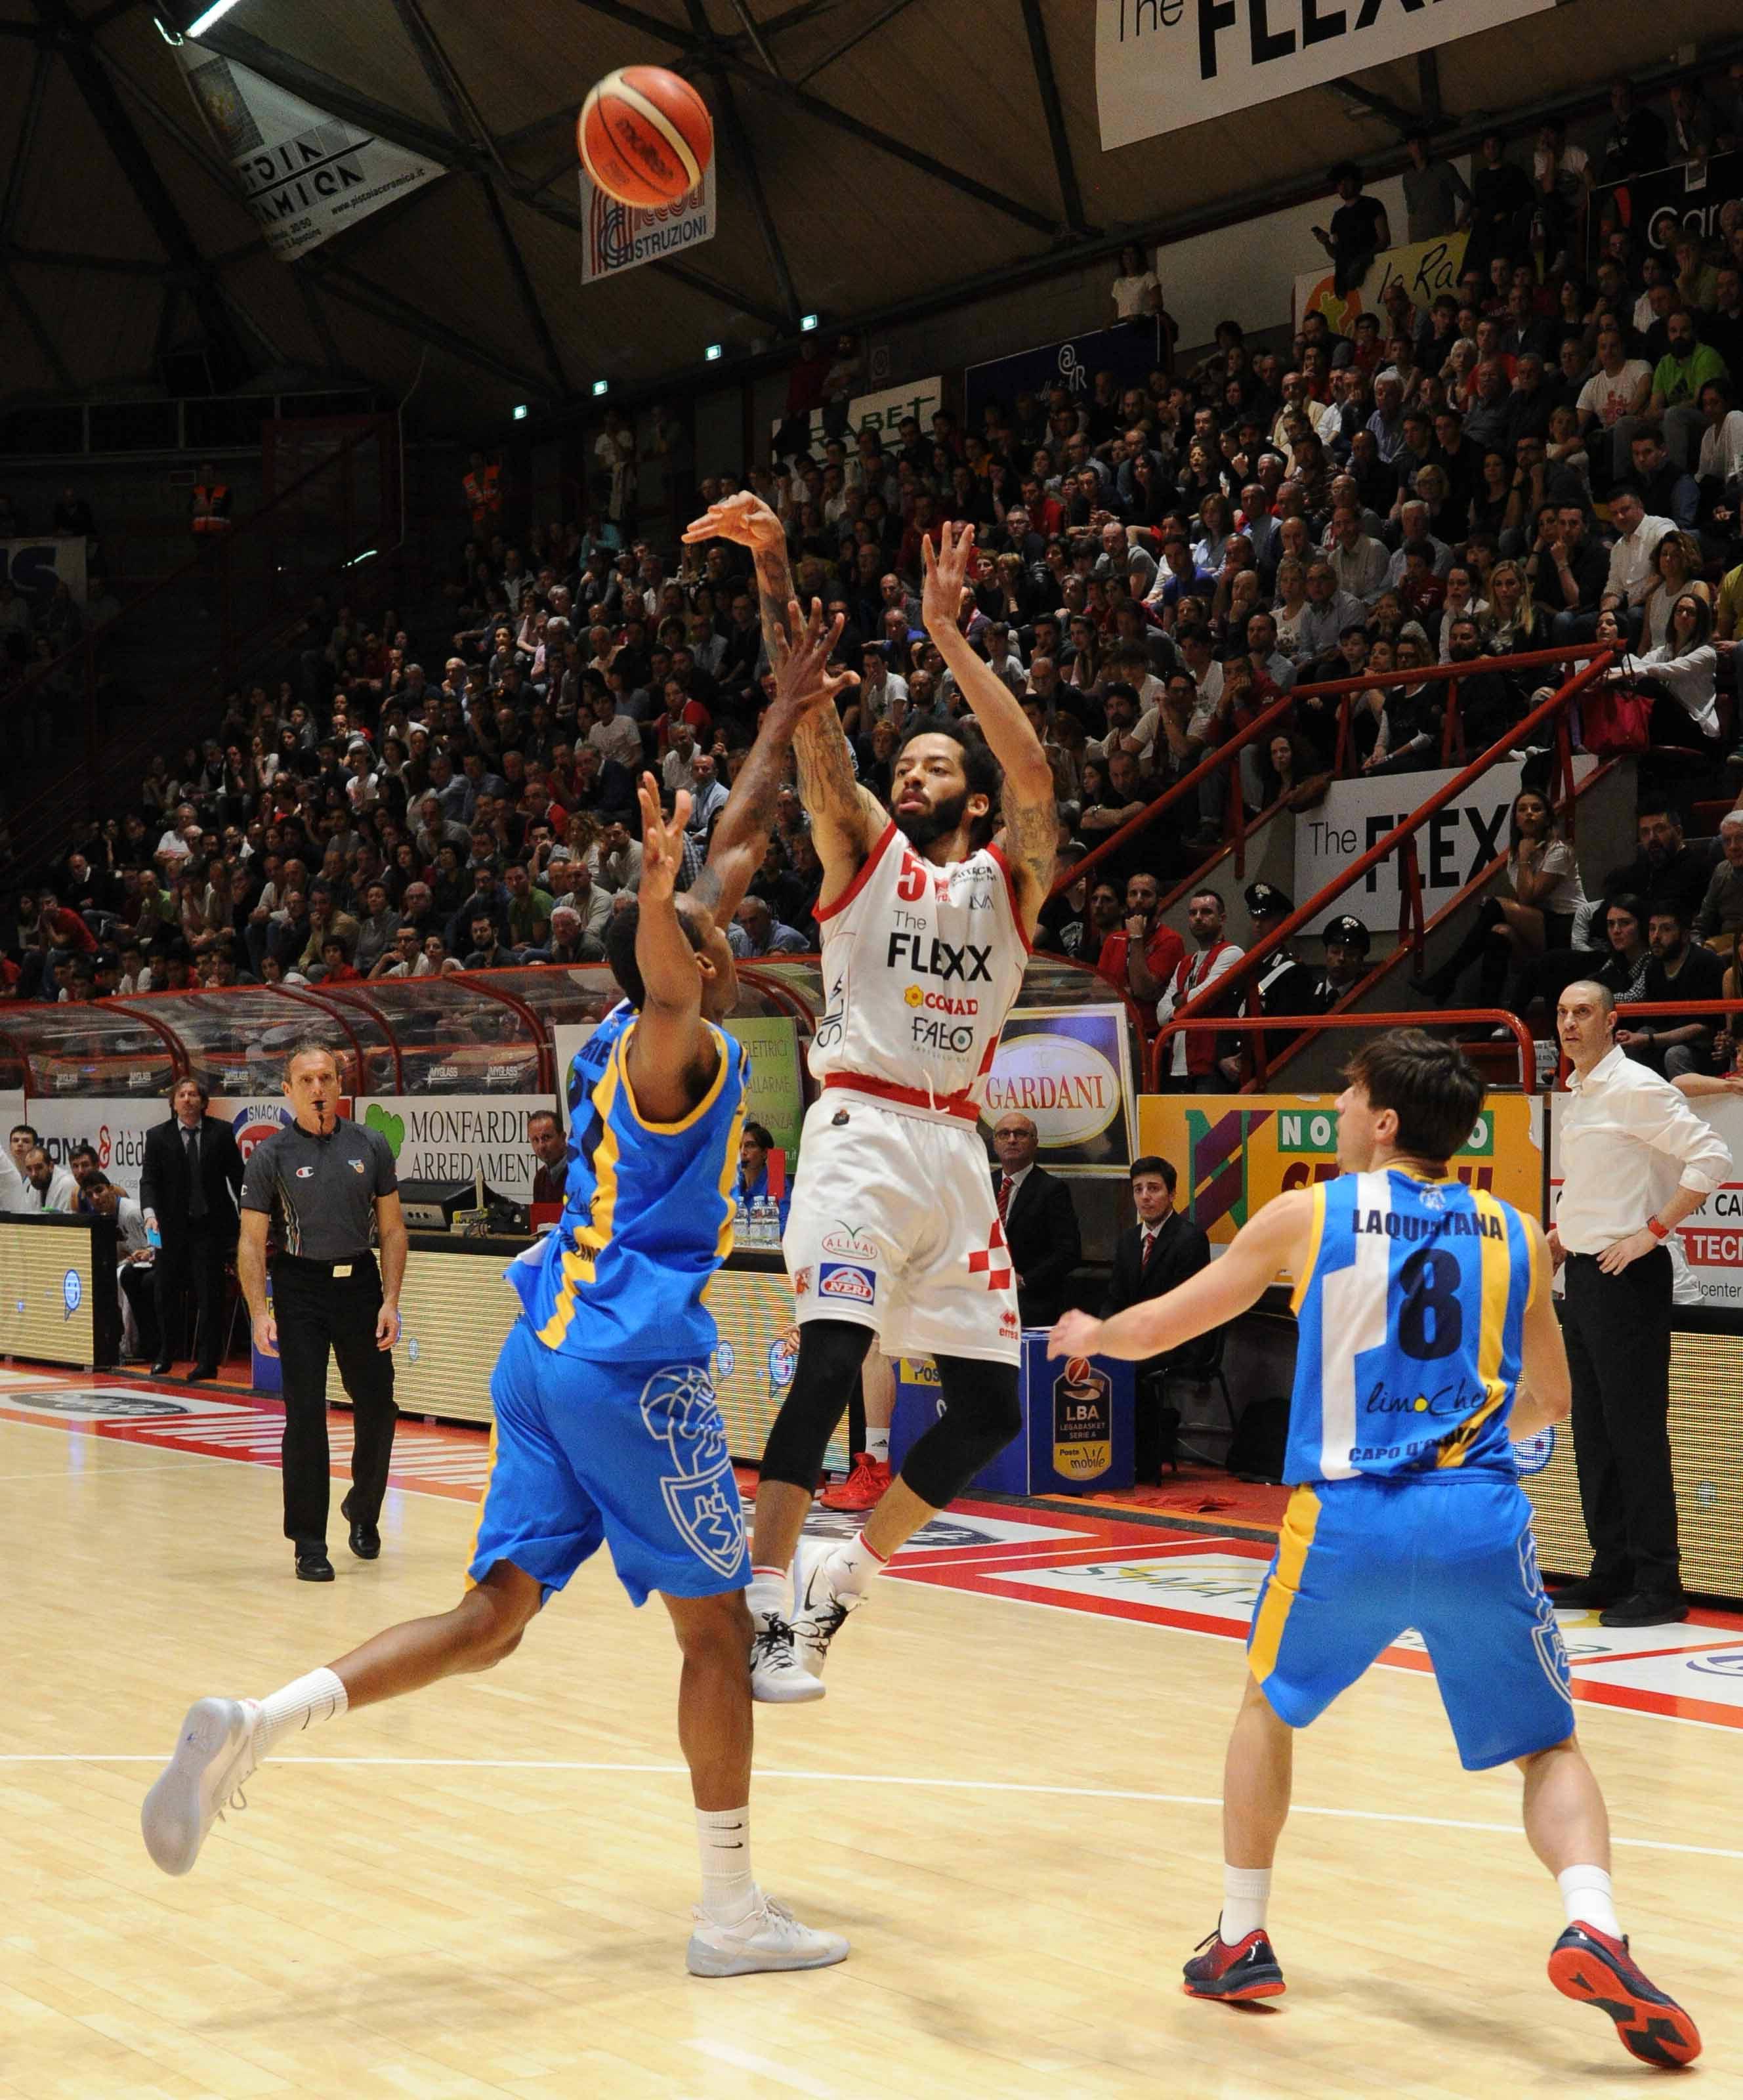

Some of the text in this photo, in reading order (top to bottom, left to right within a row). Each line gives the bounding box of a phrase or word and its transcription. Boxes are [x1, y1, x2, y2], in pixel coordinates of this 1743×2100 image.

[1309, 822, 1357, 856] The
[896, 850, 927, 902] 5
[893, 910, 927, 931] The
[429, 1066, 459, 1078] MYGLASS
[488, 1065, 518, 1077] MYGLASS
[986, 1074, 1106, 1110] GARDANI
[248, 1104, 279, 1121] SNACK
[830, 1281, 868, 1297] NERI
[1398, 1248, 1463, 1361] 8
[1066, 1405, 1100, 1421] LBA
[1060, 1422, 1106, 1431] LEGABASKET
[1070, 1445, 1106, 1469] mobile
[1348, 1446, 1401, 1462] CAPO
